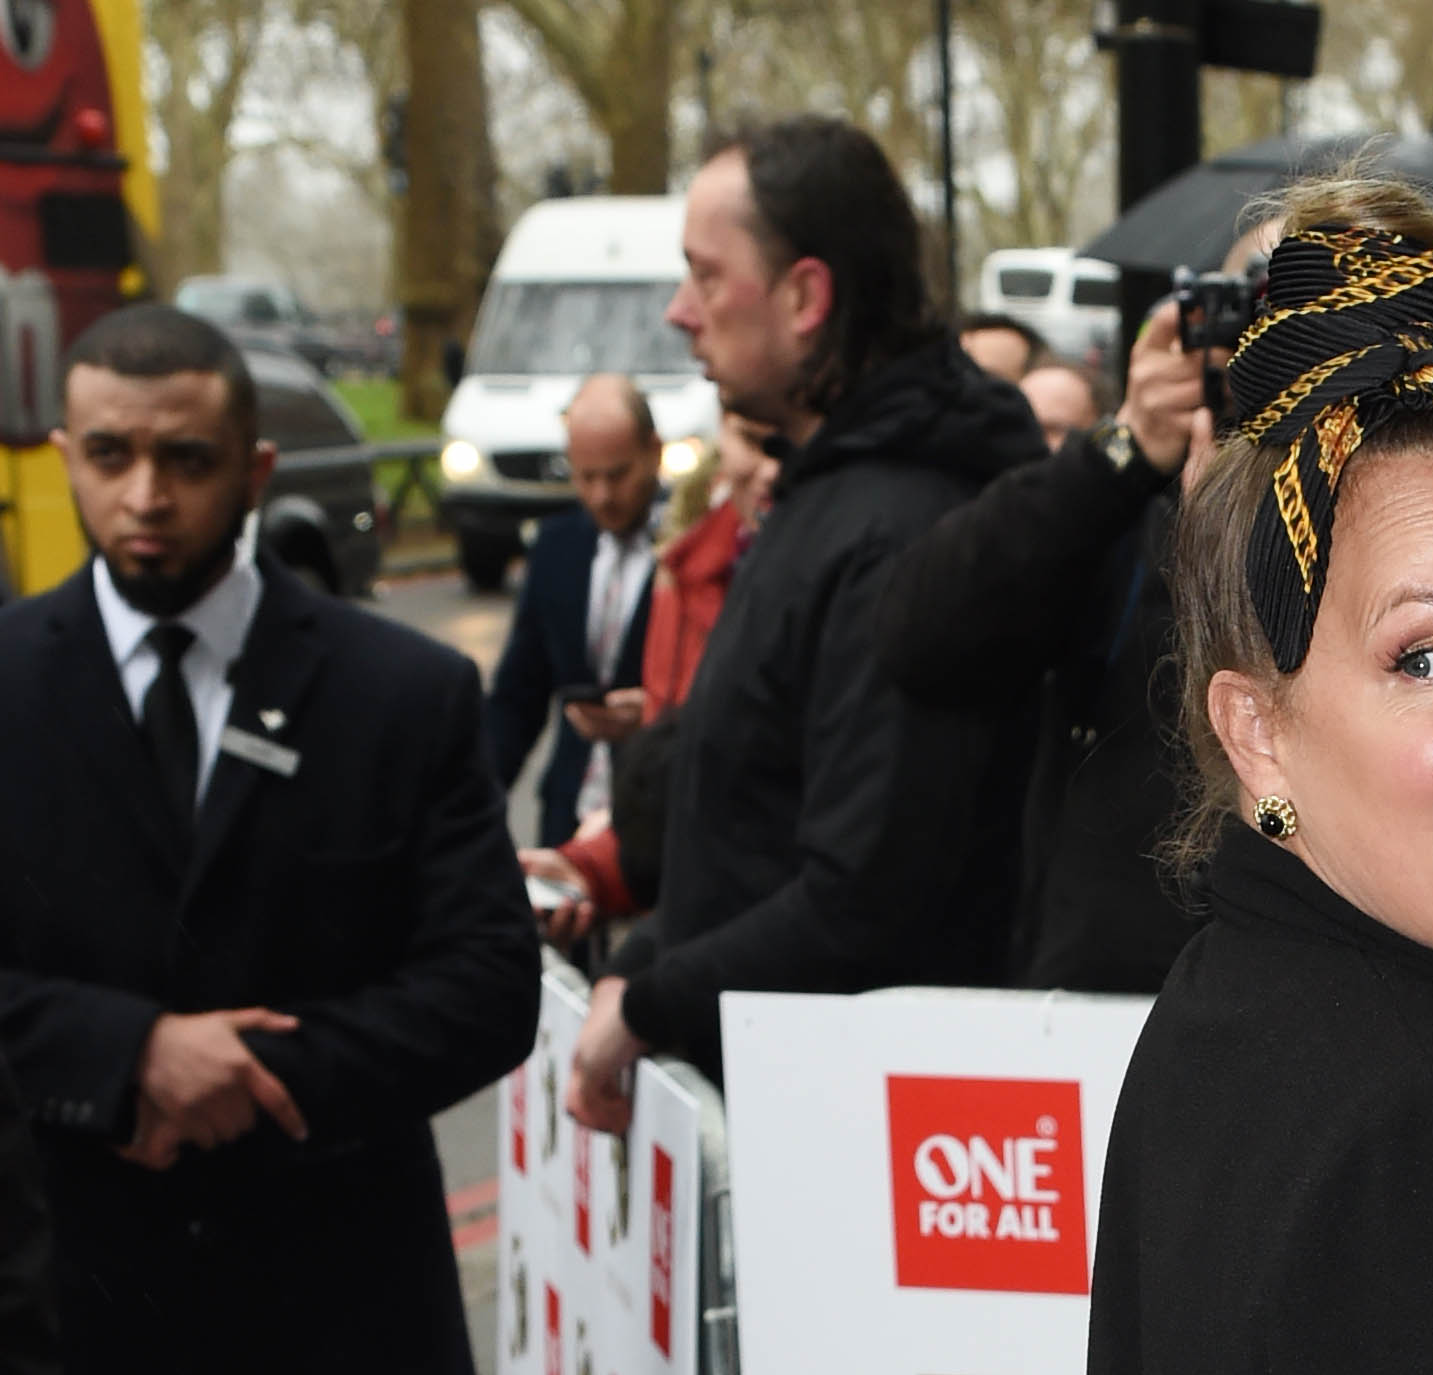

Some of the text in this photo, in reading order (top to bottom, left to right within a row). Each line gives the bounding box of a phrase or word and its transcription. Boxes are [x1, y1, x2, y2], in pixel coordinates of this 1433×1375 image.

[914, 1133, 1060, 1204] ONE
[918, 1200, 1060, 1243] FOR ALL
